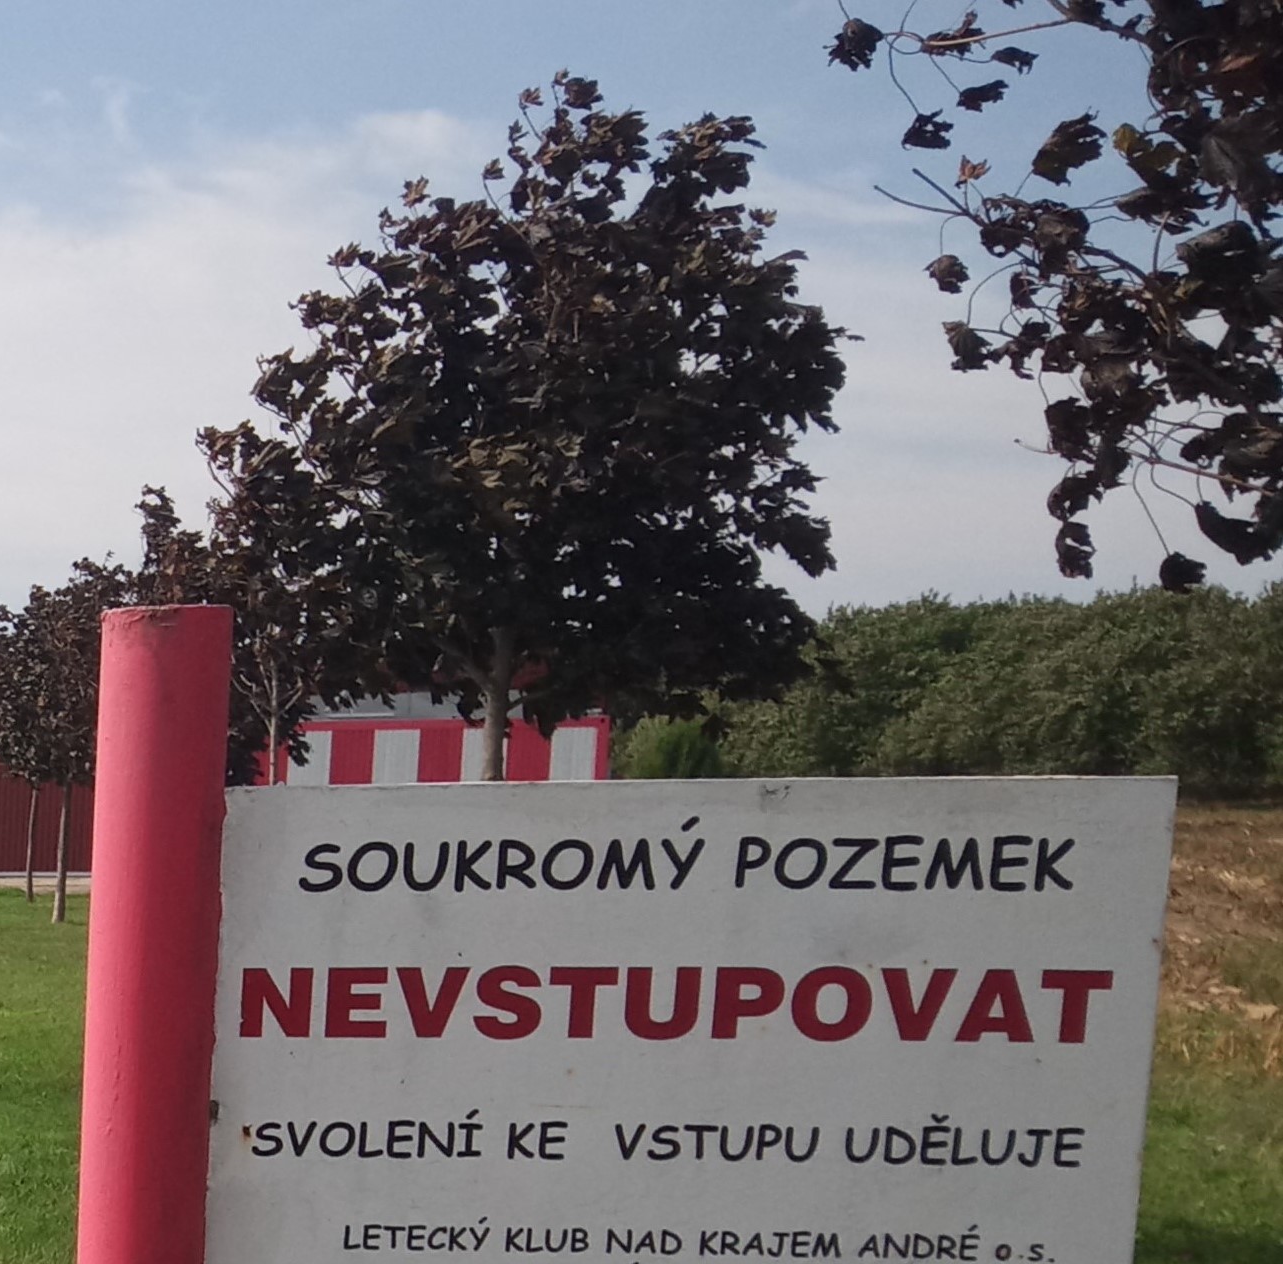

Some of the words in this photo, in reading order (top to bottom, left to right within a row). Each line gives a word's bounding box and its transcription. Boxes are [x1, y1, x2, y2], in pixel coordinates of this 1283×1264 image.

[298, 815, 706, 893] SOUKROMÝ
[734, 834, 1076, 893] POZEMEK
[238, 965, 1115, 1044] NEVSTUPOVAT
[250, 1108, 485, 1160] SVOLENÍ
[507, 1120, 569, 1161] KE
[614, 1123, 820, 1163] VSTUPU
[844, 1113, 1086, 1168] UDĚLUJE
[343, 1216, 491, 1252] LETECKÝ
[504, 1226, 590, 1254] KLUB
[605, 1228, 683, 1256] NAD
[698, 1230, 842, 1259] KRAJEM
[857, 1224, 982, 1262] ANDRÉ
